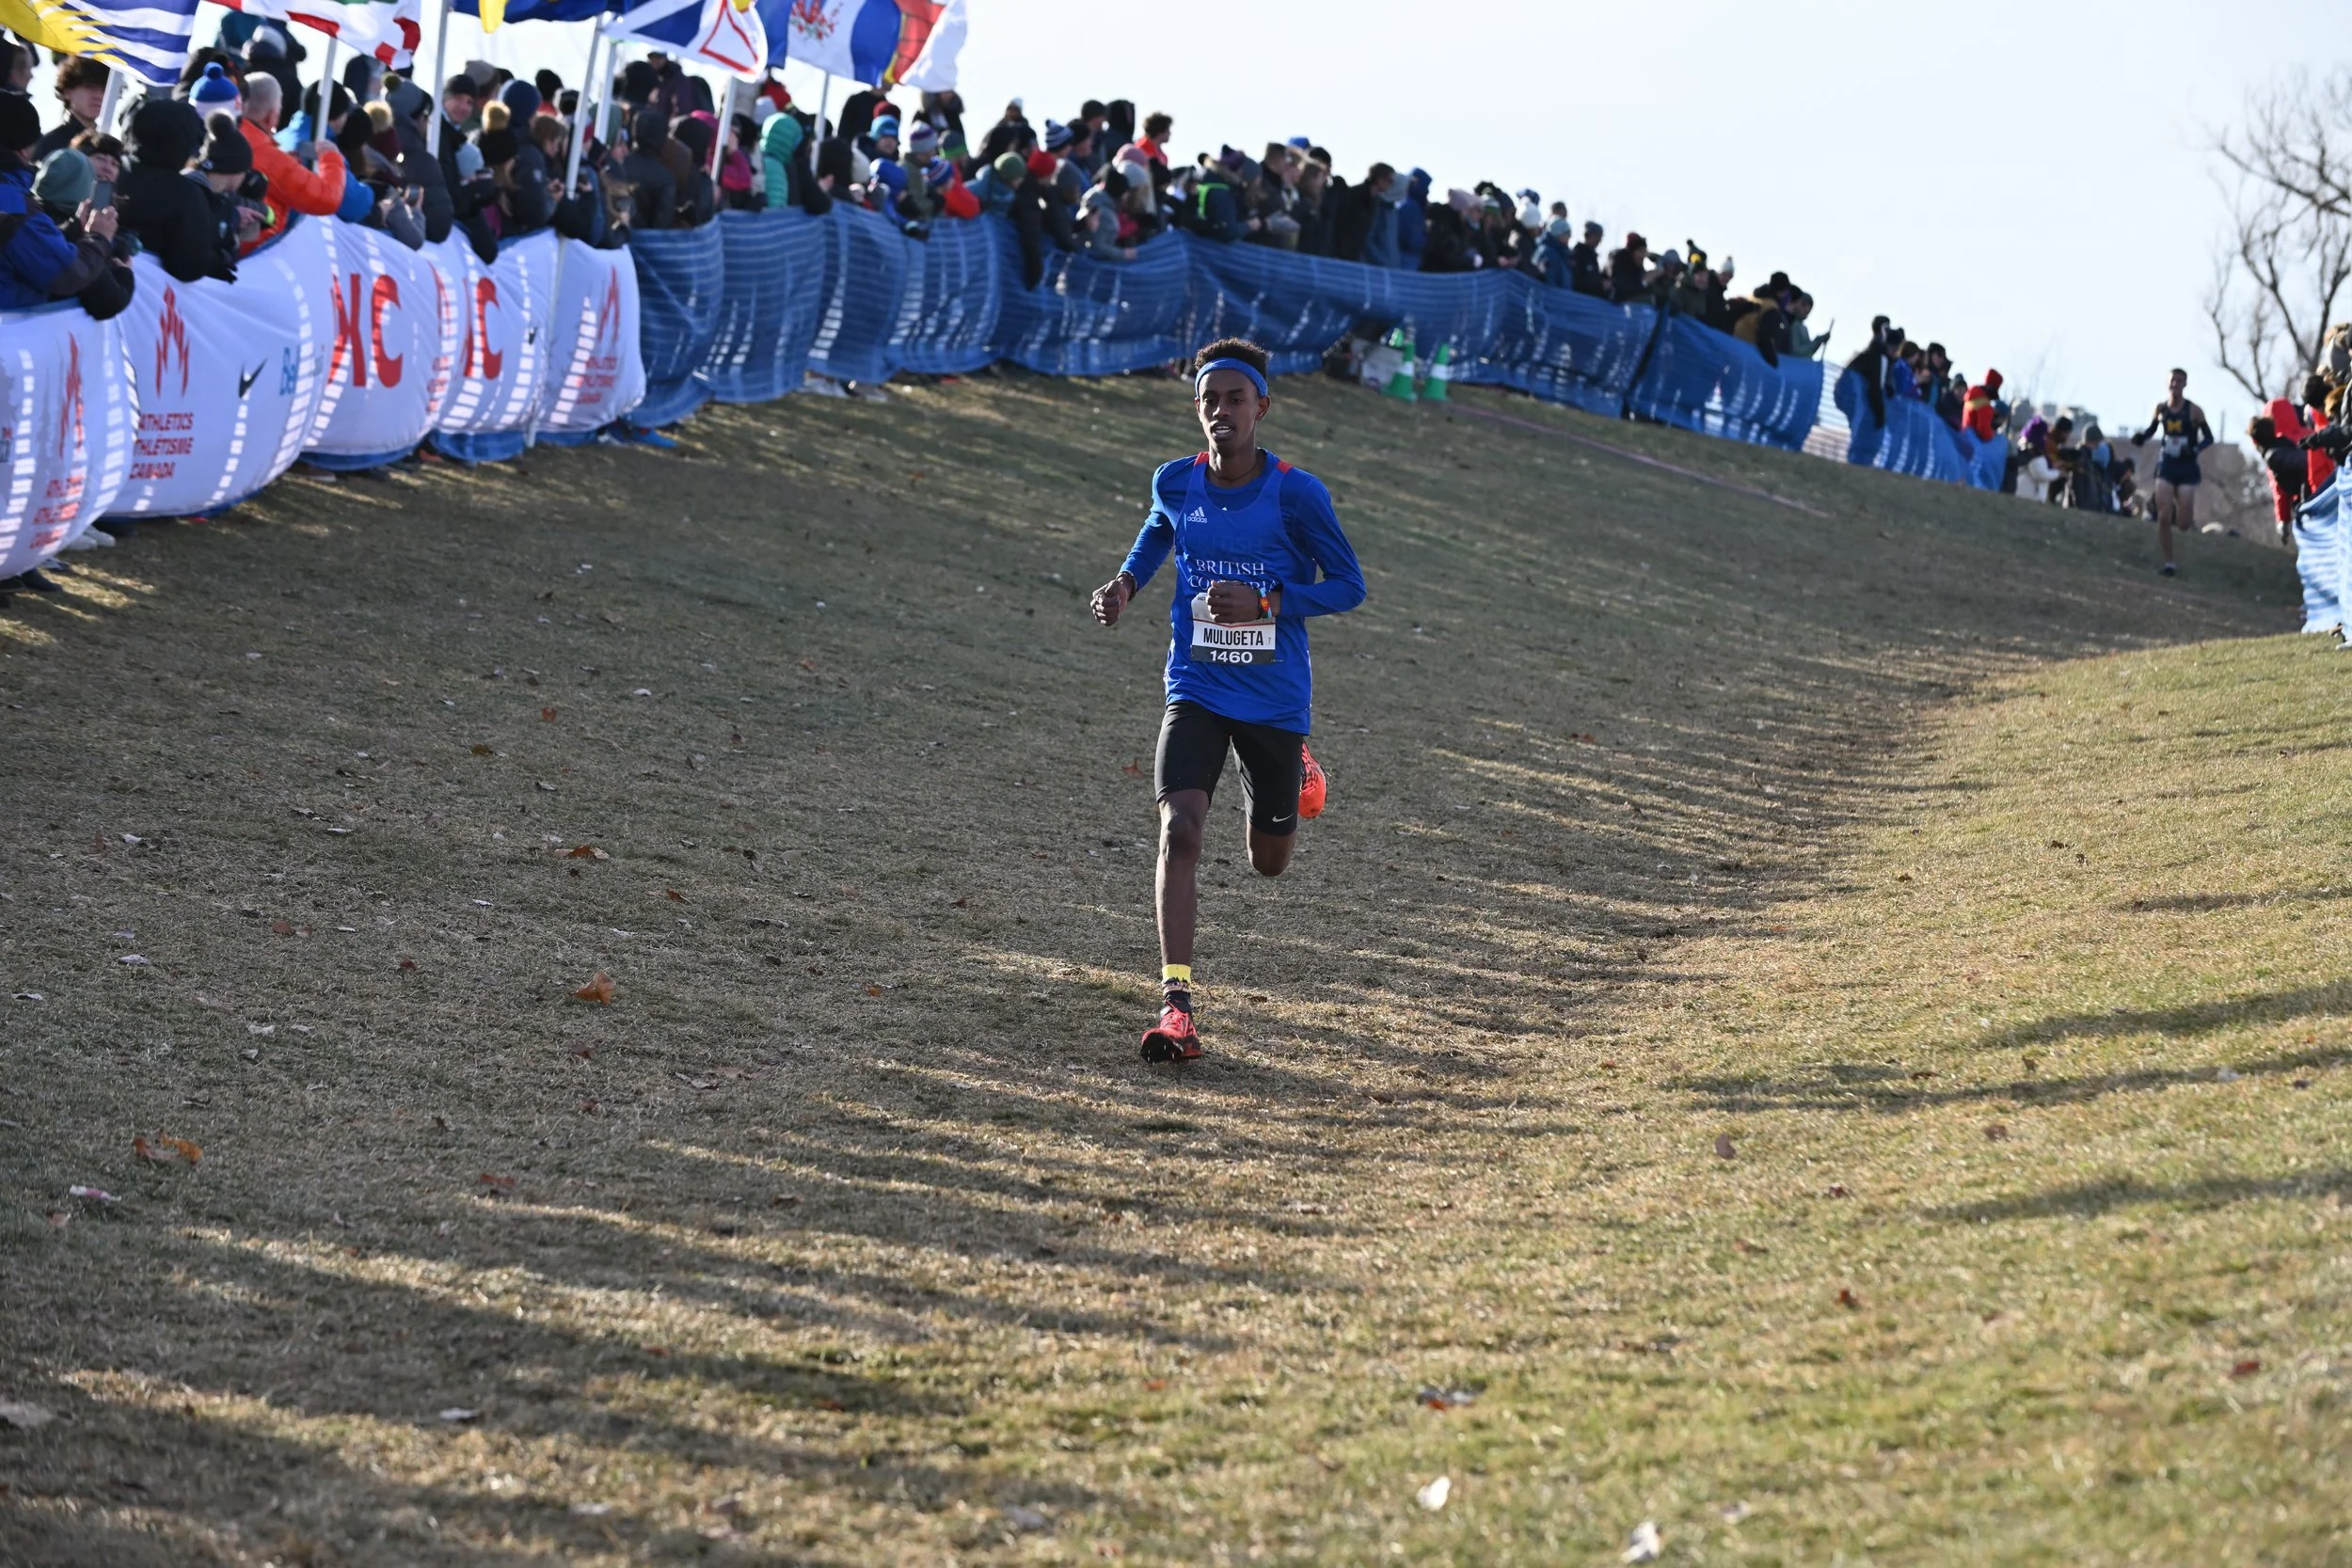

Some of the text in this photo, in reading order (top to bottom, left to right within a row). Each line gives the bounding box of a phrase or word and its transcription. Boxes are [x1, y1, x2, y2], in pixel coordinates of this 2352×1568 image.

[1186, 515, 1208, 524] adidas
[1196, 559, 1265, 576] BRITISH
[1203, 627, 1264, 646] MULUGETA
[1210, 650, 1253, 663] 1460
